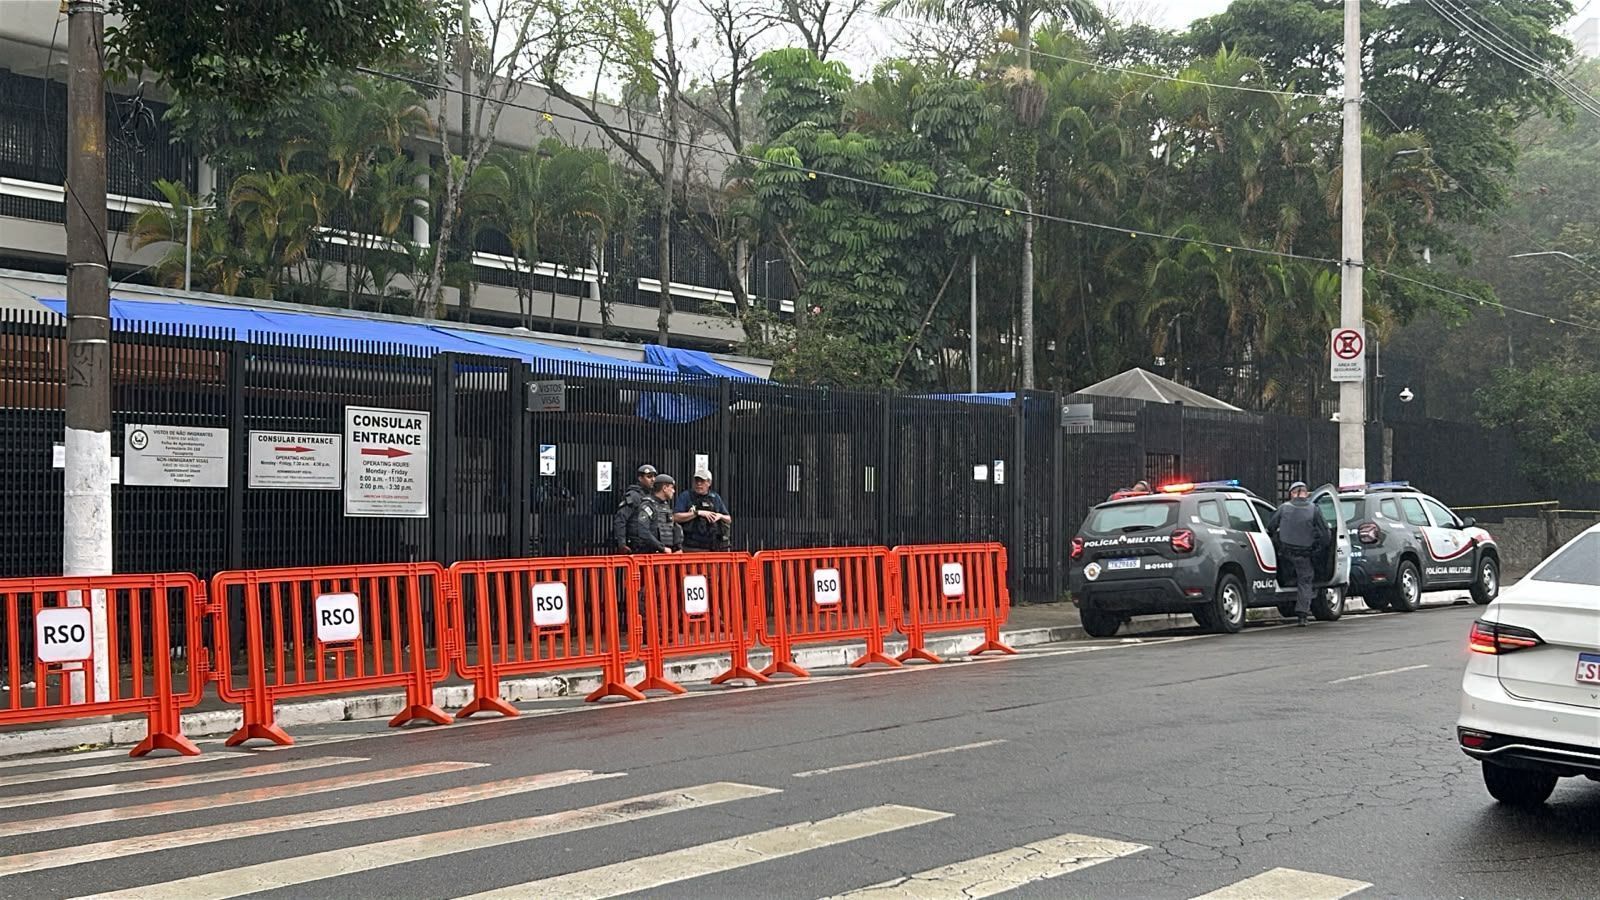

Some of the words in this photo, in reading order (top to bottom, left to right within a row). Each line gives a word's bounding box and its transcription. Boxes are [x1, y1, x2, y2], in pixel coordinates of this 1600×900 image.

[538, 384, 562, 392] VISTOS
[542, 396, 560, 404] VISAS
[353, 414, 422, 430] CONSULAR
[353, 431, 421, 446] ENTRANCE
[546, 462, 549, 471] 1
[1084, 539, 1118, 548] POLÍCIA
[1127, 536, 1170, 544] MILITAR
[1426, 566, 1447, 574] POLÍCIA
[817, 579, 836, 593] RSO
[944, 573, 960, 585] RSO
[686, 586, 704, 600] RSO
[536, 595, 563, 612] RSO
[321, 608, 354, 628] RSO
[43, 624, 86, 645] RSO
